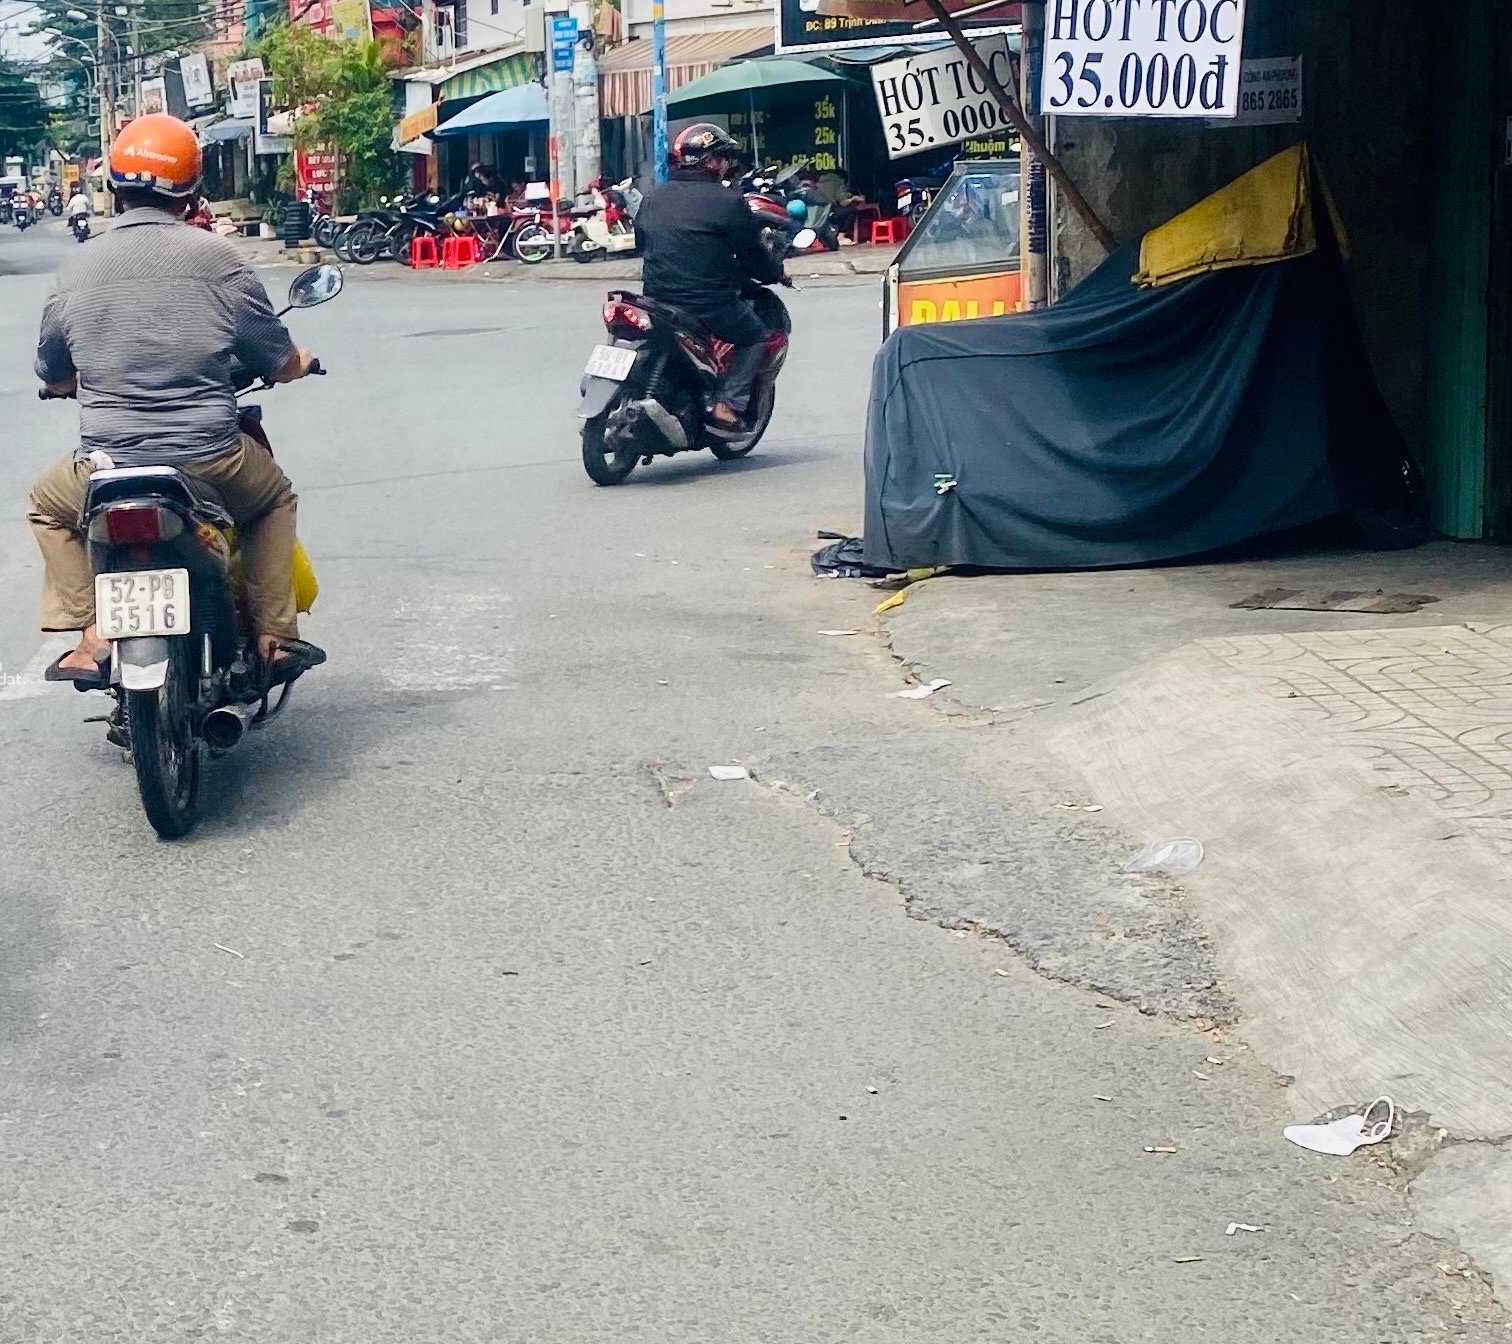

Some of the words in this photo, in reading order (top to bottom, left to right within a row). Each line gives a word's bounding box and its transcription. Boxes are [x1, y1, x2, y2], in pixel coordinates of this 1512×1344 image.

[878, 58, 941, 117] HỚT
[1050, 51, 1229, 110] 35.000đ
[814, 126, 835, 145] 25k
[815, 152, 836, 171] 60k
[109, 574, 175, 604] 52-P8
[109, 604, 176, 633] 5516
